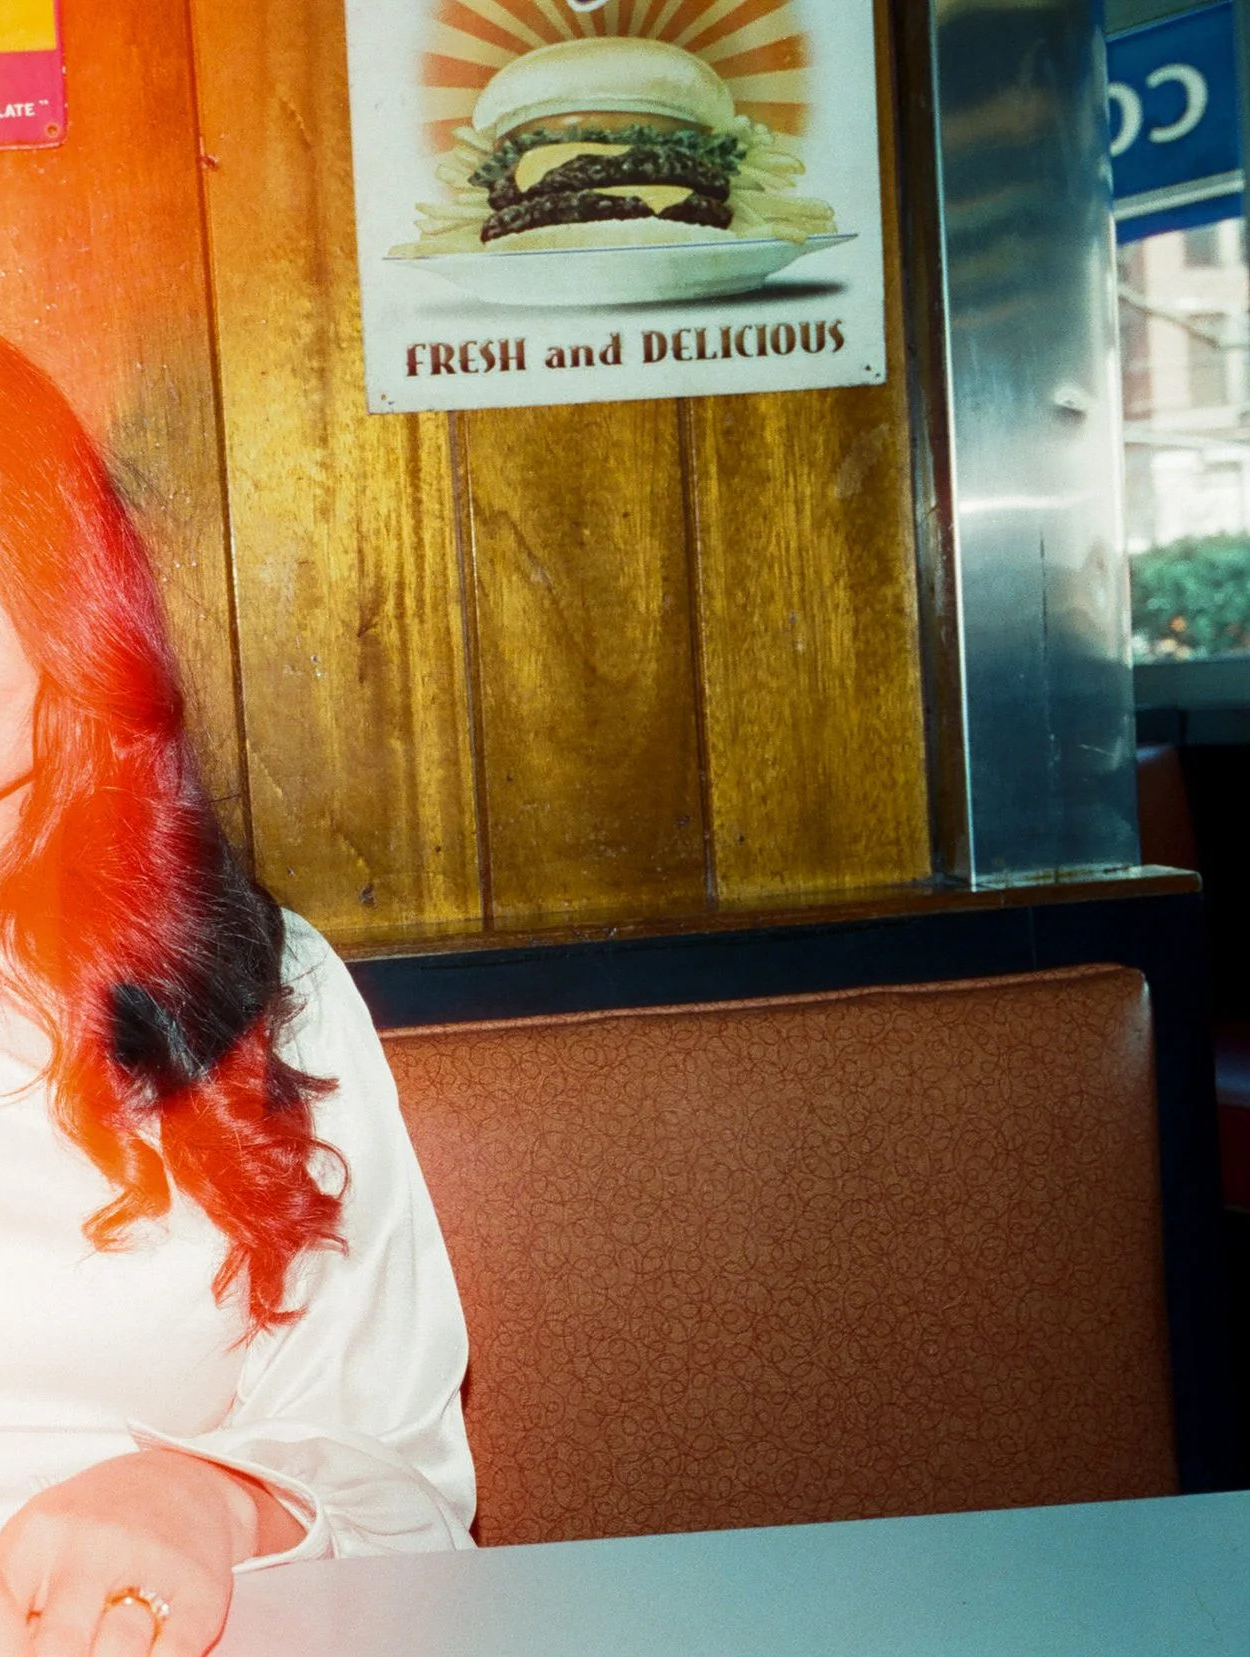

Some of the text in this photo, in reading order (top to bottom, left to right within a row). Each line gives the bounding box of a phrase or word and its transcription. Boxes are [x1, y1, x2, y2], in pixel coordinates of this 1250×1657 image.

[406, 319, 845, 377] FRESH and DELICIOUS
